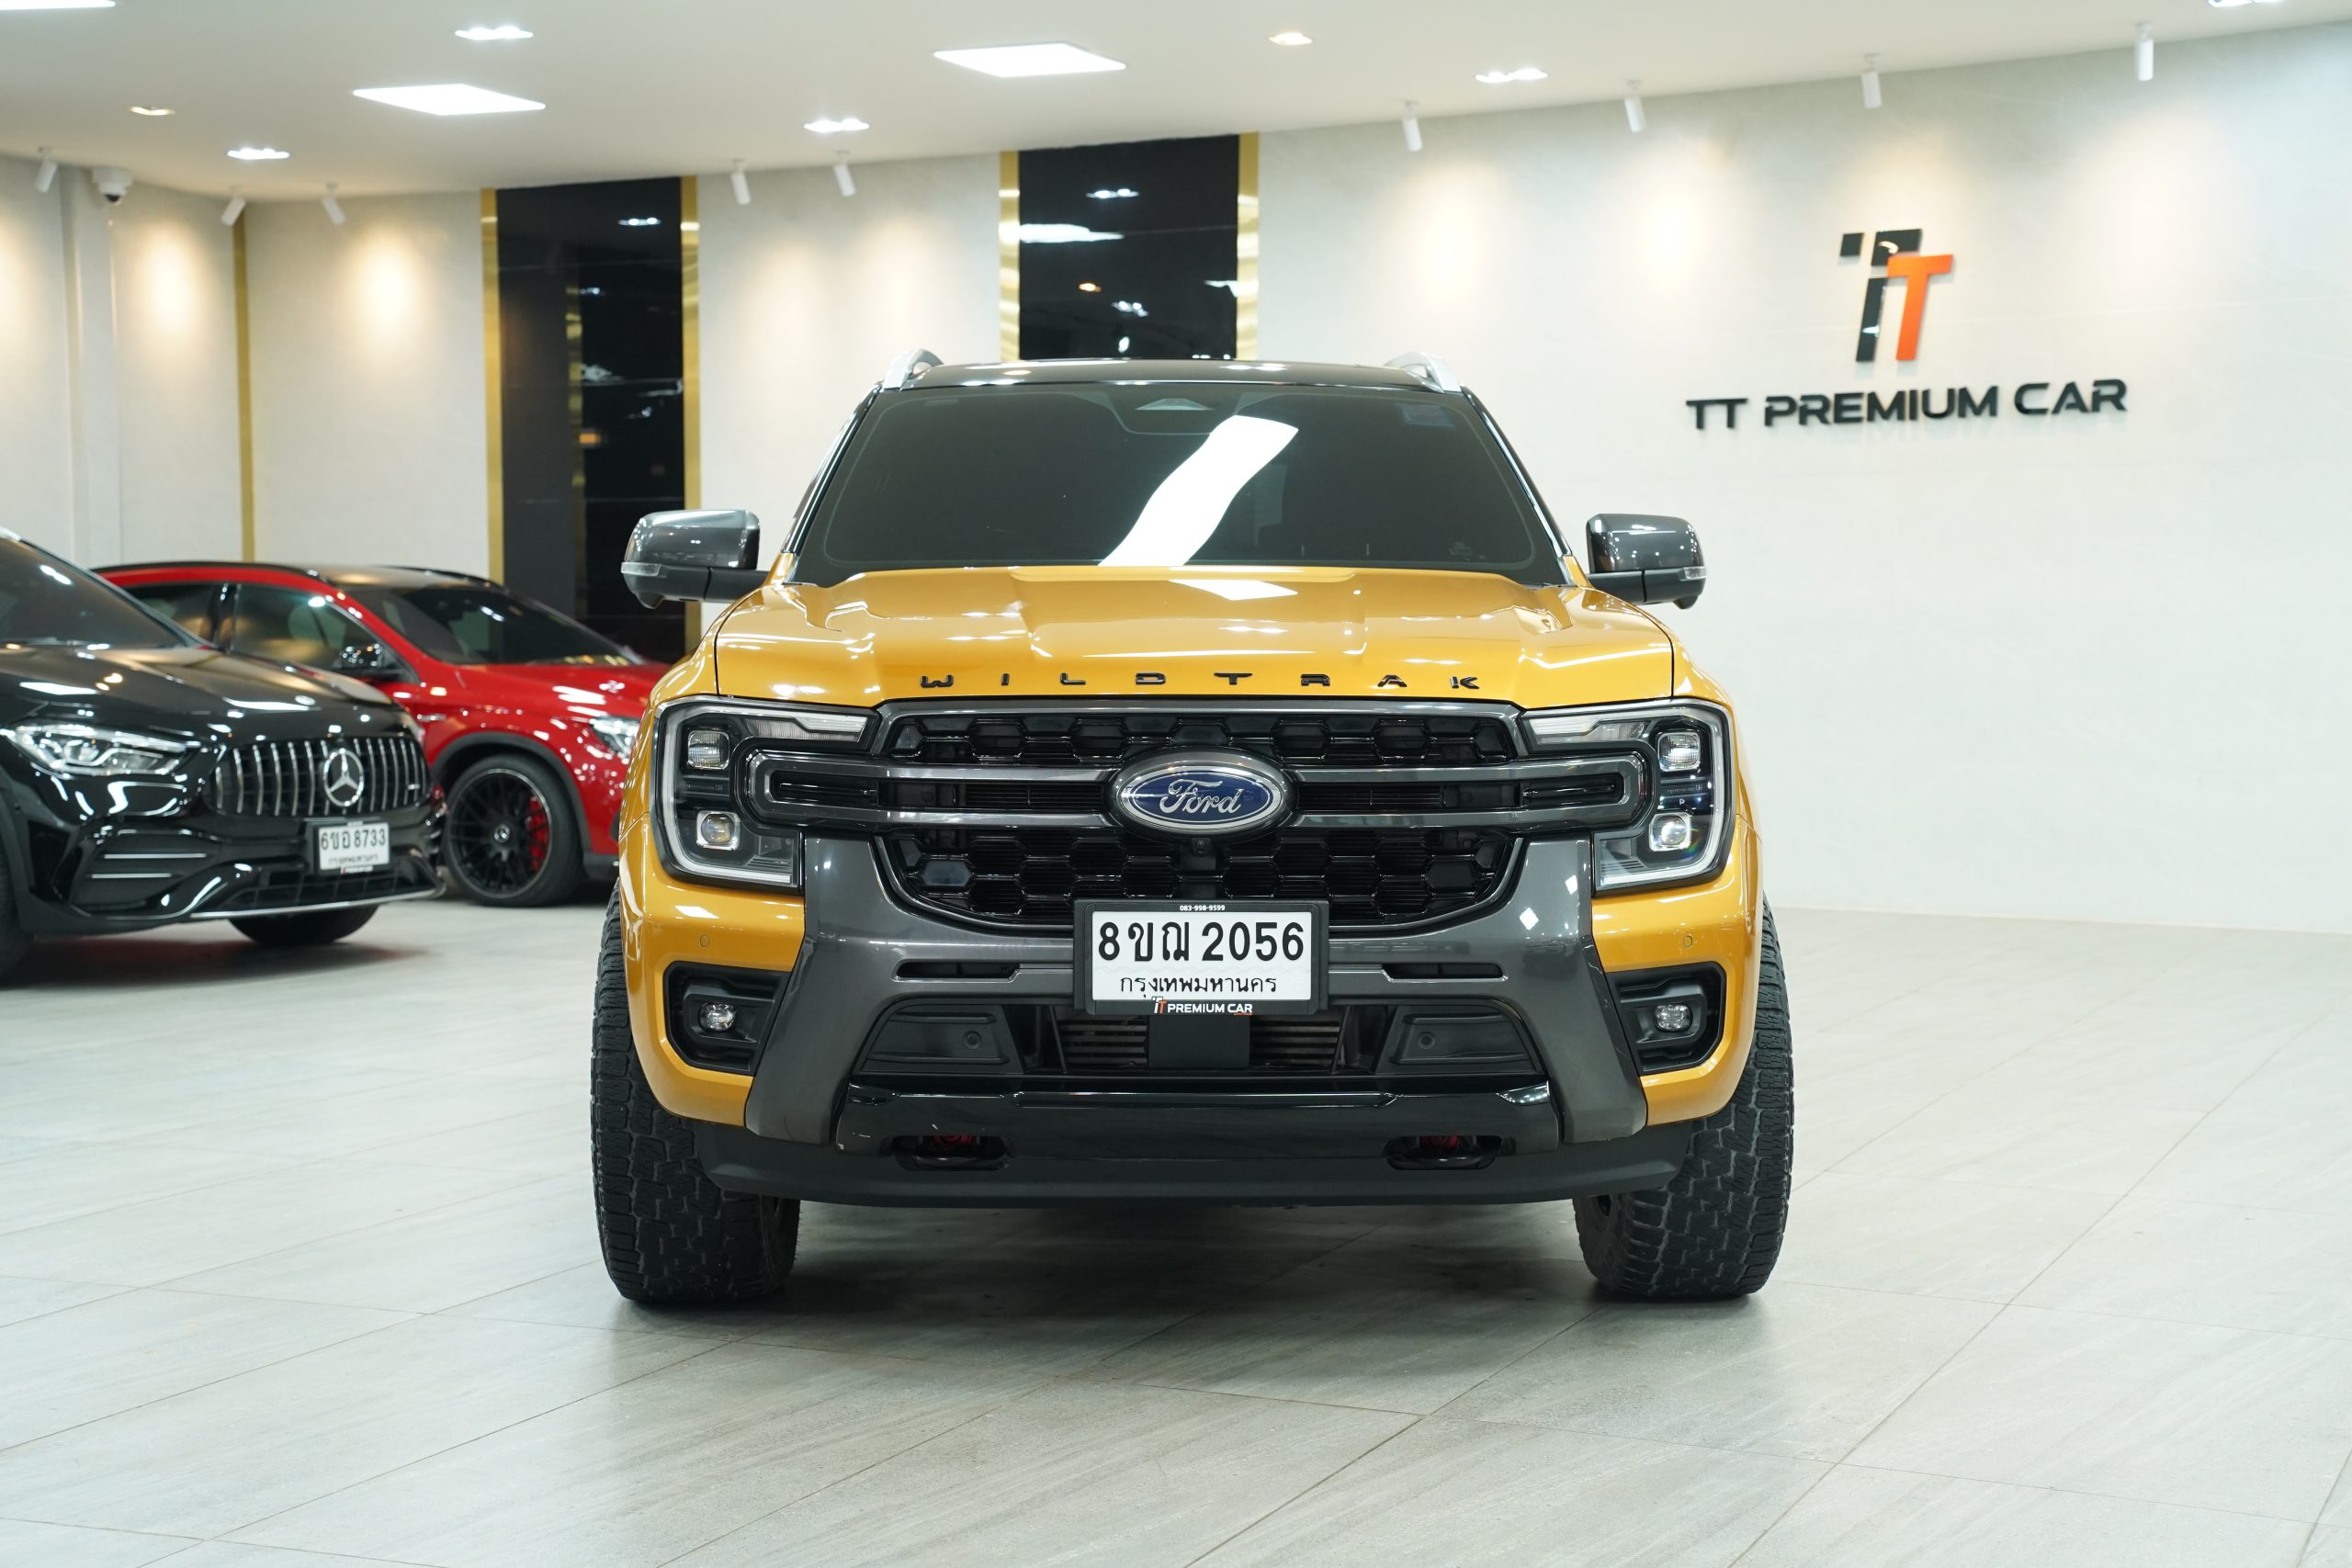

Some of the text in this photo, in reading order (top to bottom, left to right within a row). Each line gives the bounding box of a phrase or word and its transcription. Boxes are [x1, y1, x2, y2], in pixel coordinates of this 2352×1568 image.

[1685, 378, 2128, 430] TT PREMIUM CAR
[921, 671, 1480, 689] WILDTRAK
[1159, 778, 1244, 816] Ford
[353, 828, 386, 848] 8733
[1202, 921, 1305, 962] 2056
[1120, 976, 1277, 998] กรุงเทพมหานคร
[1167, 1003, 1226, 1013] PREMIUM
[1227, 1003, 1253, 1014] CAR
